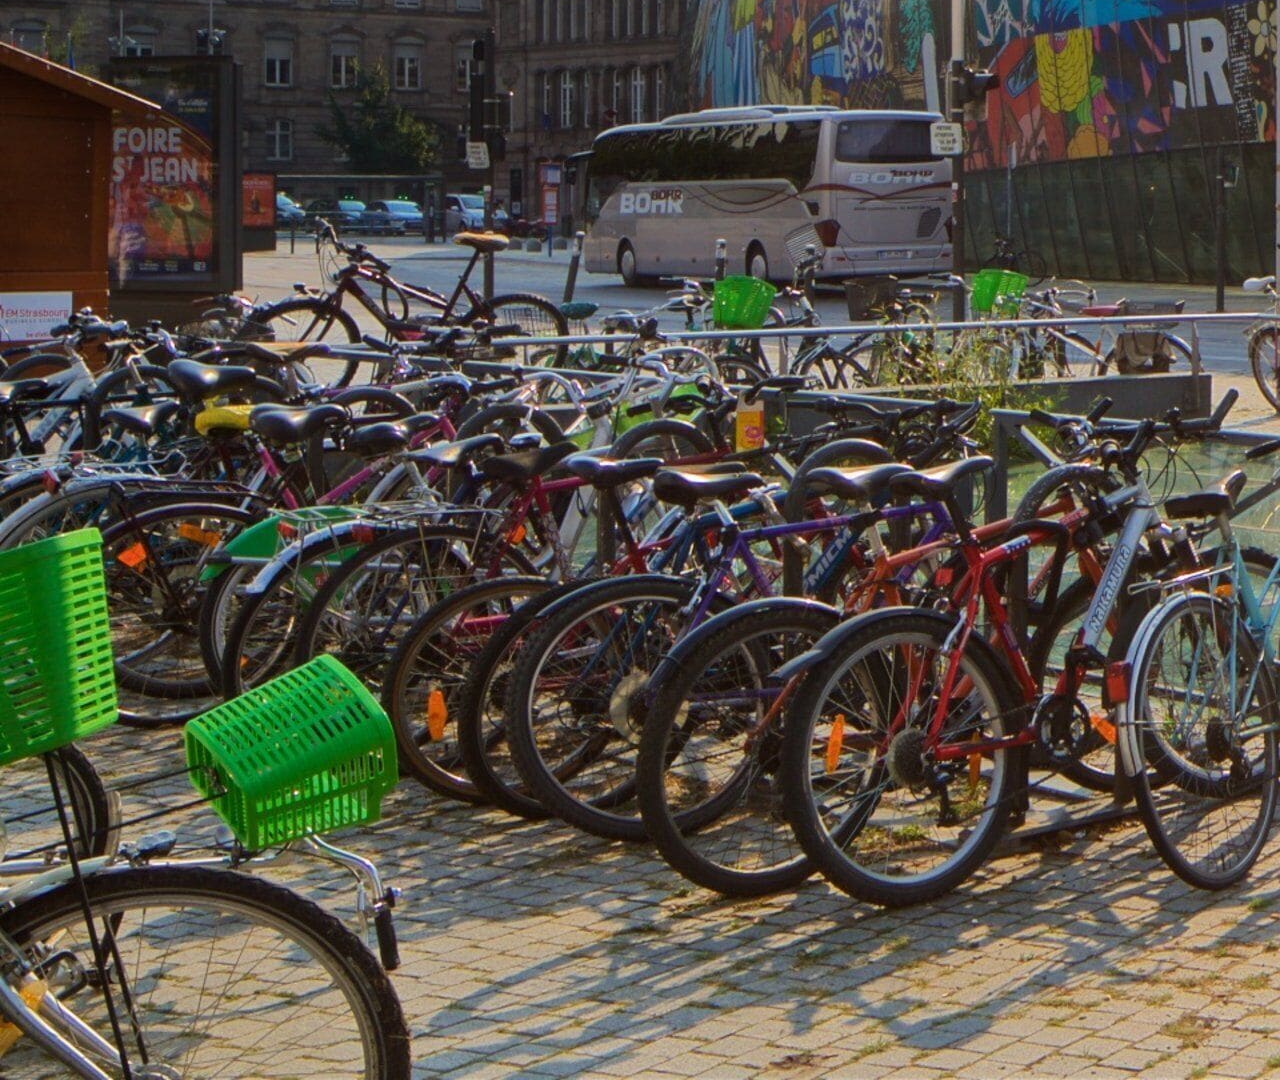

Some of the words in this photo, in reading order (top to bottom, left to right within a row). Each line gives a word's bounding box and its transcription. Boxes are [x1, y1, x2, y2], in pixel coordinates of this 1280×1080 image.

[112, 126, 182, 154] FOIRE
[139, 156, 199, 183] JEAN
[619, 191, 684, 215] BOHR
